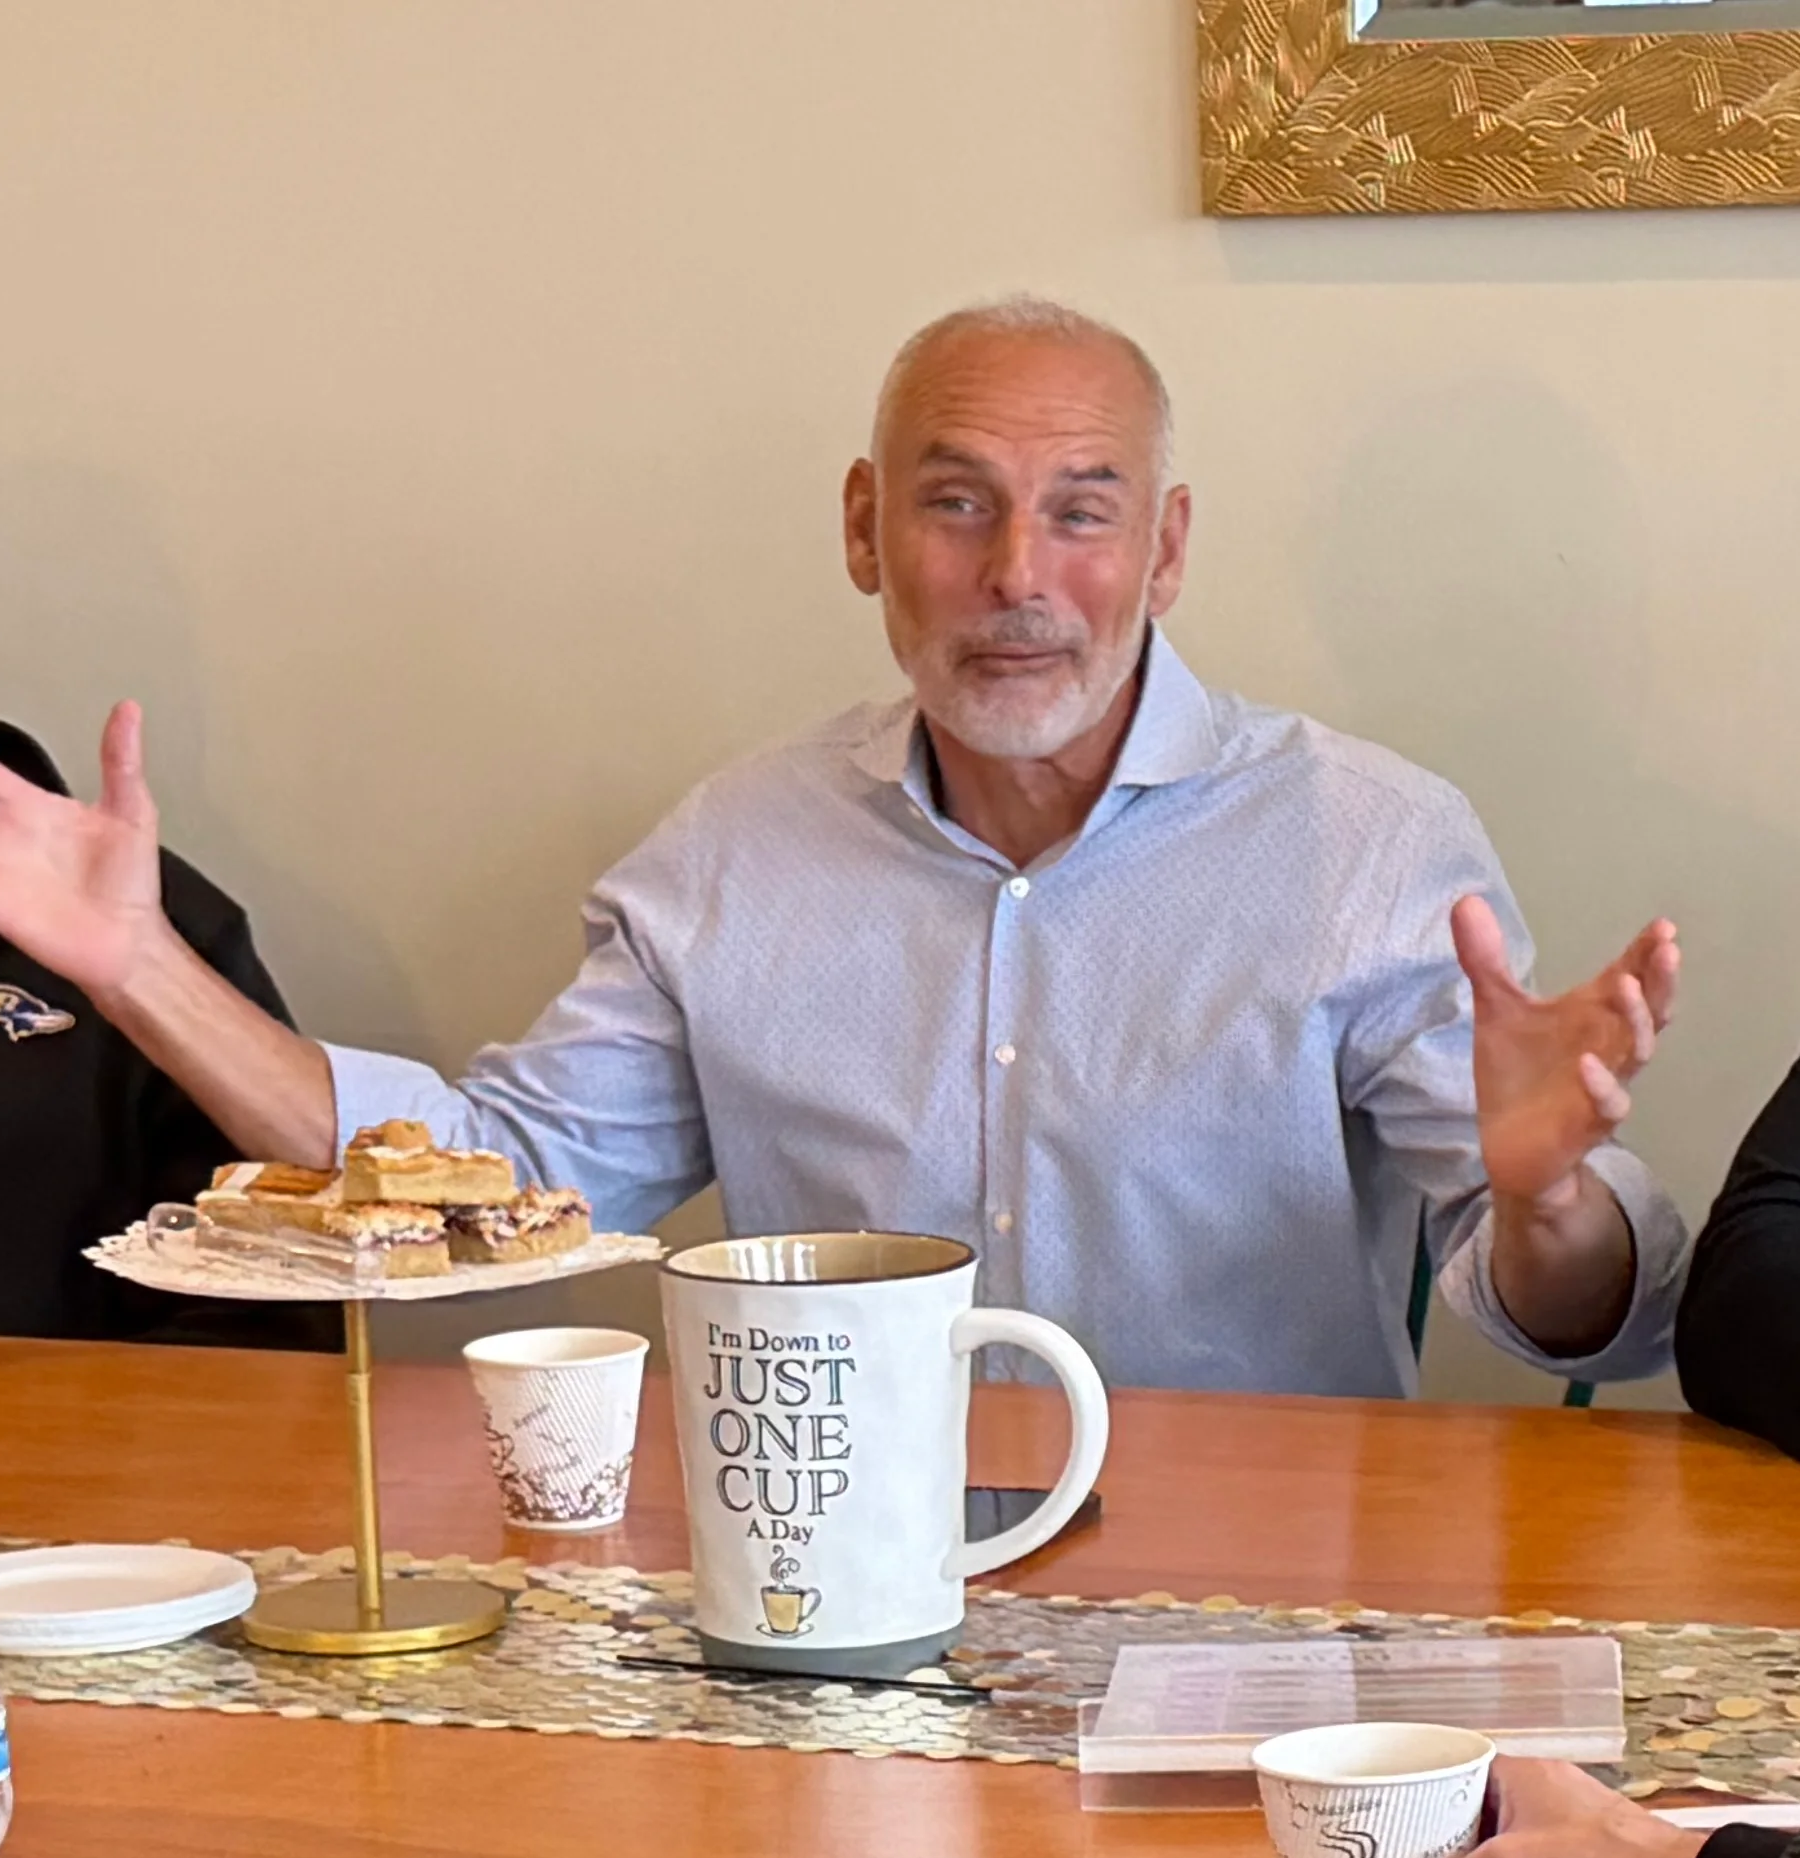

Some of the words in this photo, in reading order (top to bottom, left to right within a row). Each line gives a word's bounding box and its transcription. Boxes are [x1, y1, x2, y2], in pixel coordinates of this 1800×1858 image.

[708, 1321, 741, 1348] I'm
[748, 1327, 819, 1351] Down
[828, 1333, 851, 1351] to
[704, 1353, 856, 1406] JUST
[710, 1408, 853, 1461] ONE
[716, 1464, 850, 1516] CUP
[747, 1518, 765, 1539] A
[770, 1519, 814, 1545] Day
